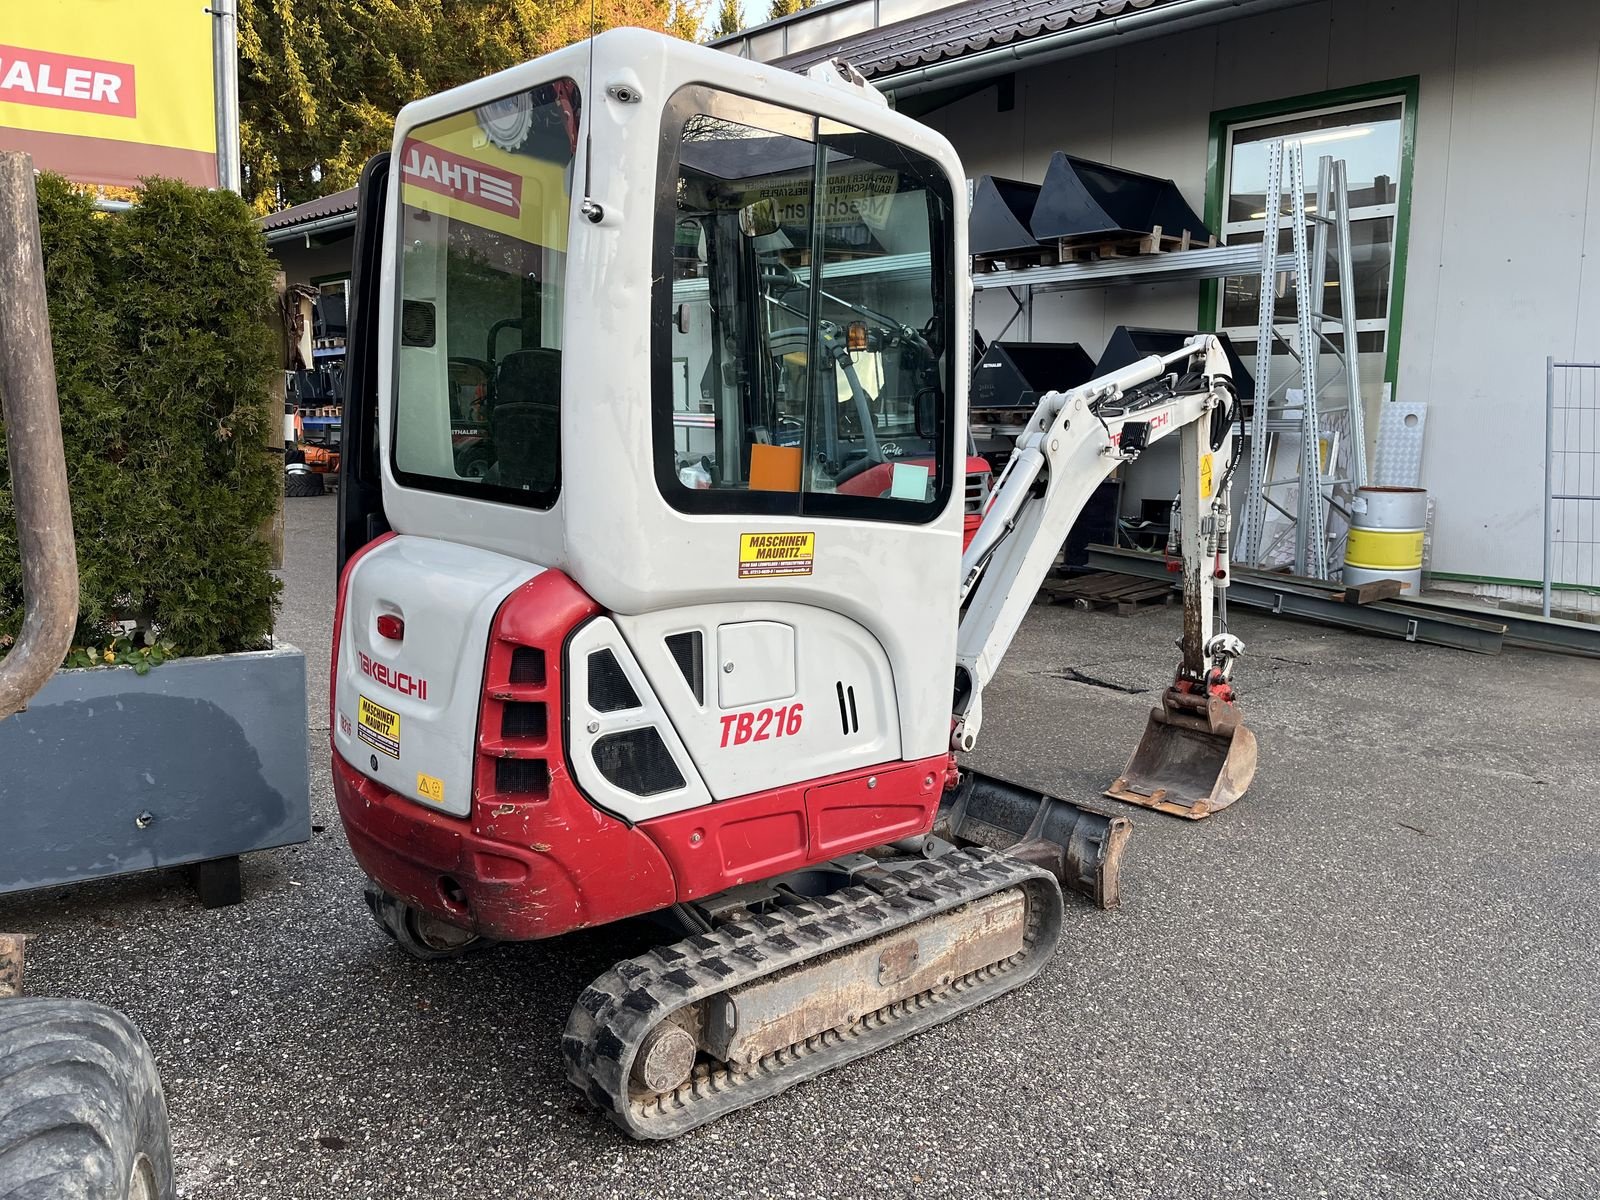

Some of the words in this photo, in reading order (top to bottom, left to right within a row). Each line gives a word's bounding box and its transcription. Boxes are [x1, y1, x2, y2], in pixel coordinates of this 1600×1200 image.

[0, 57, 122, 104] ALER
[749, 535, 808, 548] MASCHINEN
[756, 547, 801, 559] MAURITZ
[362, 700, 395, 726] MASCHINEN
[365, 714, 391, 737] MAURITZ
[719, 703, 804, 748] TB216
